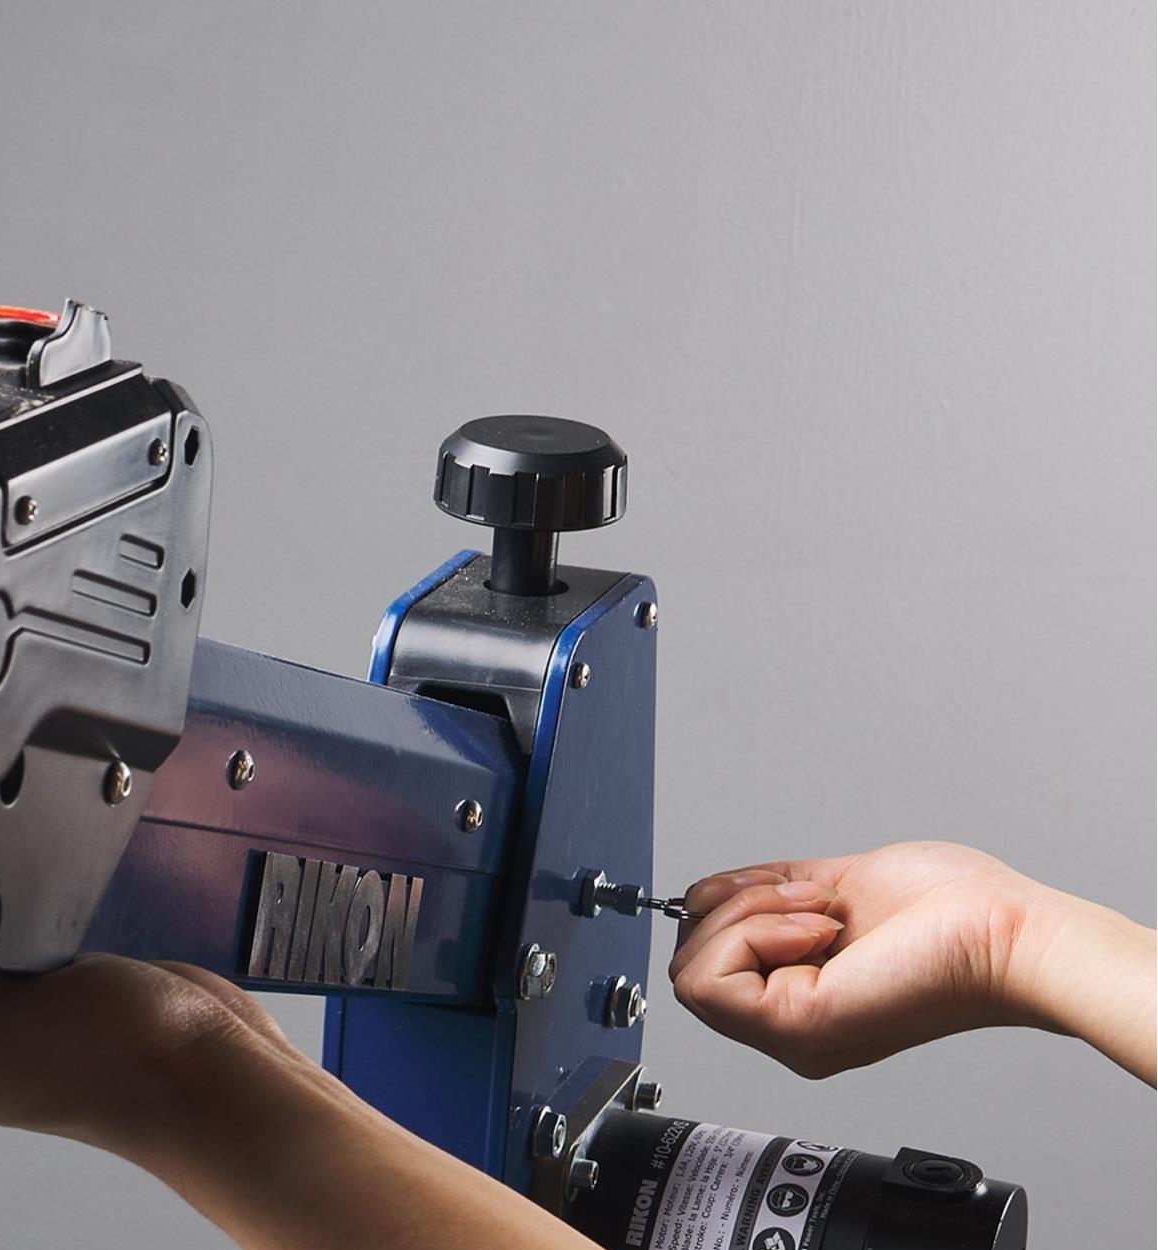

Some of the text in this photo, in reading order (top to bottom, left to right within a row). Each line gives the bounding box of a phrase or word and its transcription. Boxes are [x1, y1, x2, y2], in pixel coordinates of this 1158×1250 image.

[249, 851, 424, 989] RIKON
[626, 1179, 658, 1246] RIKON
[655, 1219, 670, 1249] Motor:
[664, 1183, 680, 1216] Moteur:
[677, 1184, 694, 1216] Vitesse:
[692, 1185, 707, 1214] Lame:
[702, 1193, 717, 1219] Coup:
[711, 1161, 729, 1191] Carrera:
[720, 1184, 739, 1221] Numéro:
[737, 1188, 760, 1246] WARNING
[803, 1224, 814, 1248] Power
